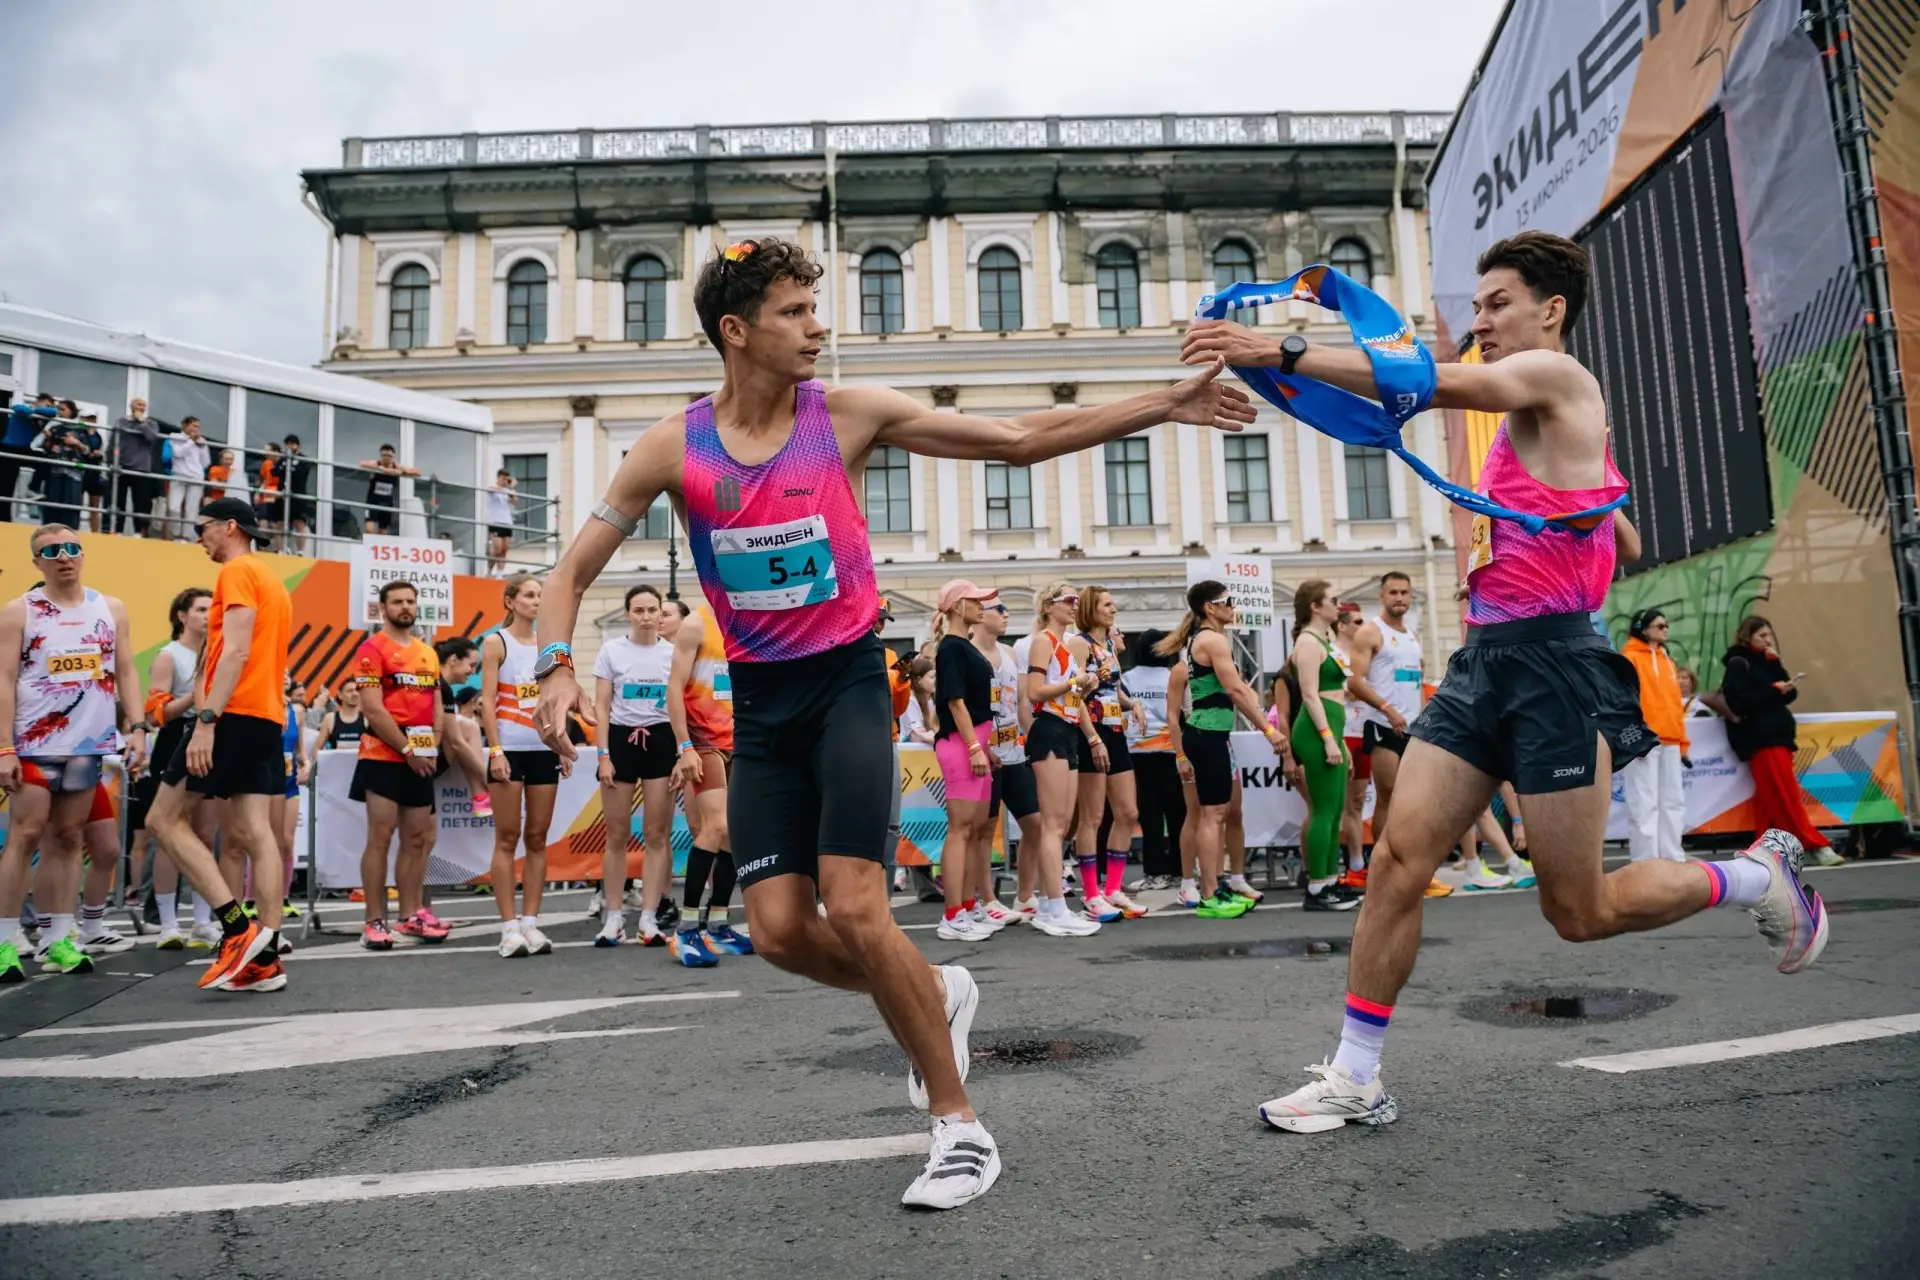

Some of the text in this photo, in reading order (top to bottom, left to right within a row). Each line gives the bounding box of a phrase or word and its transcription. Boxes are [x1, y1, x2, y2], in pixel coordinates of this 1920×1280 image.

[1577, 104, 1620, 167] 2026
[746, 527, 814, 548] ЭКИДЕН
[370, 545, 446, 565] 151-300
[369, 569, 449, 584] ПЕРЕДАЧА
[768, 556, 818, 586] 5-4
[1224, 563, 1259, 577] 1-150
[1224, 583, 1271, 594] ЕРЕДАЧА
[1230, 597, 1271, 608] ТАФЕТЫ
[1235, 612, 1272, 627] ИДЕН
[52, 657, 97, 672] 203-3
[635, 687, 663, 699] 47-4
[1130, 691, 1165, 700] КИДЕ
[442, 788, 468, 797] МЫ
[442, 802, 473, 813] СПО
